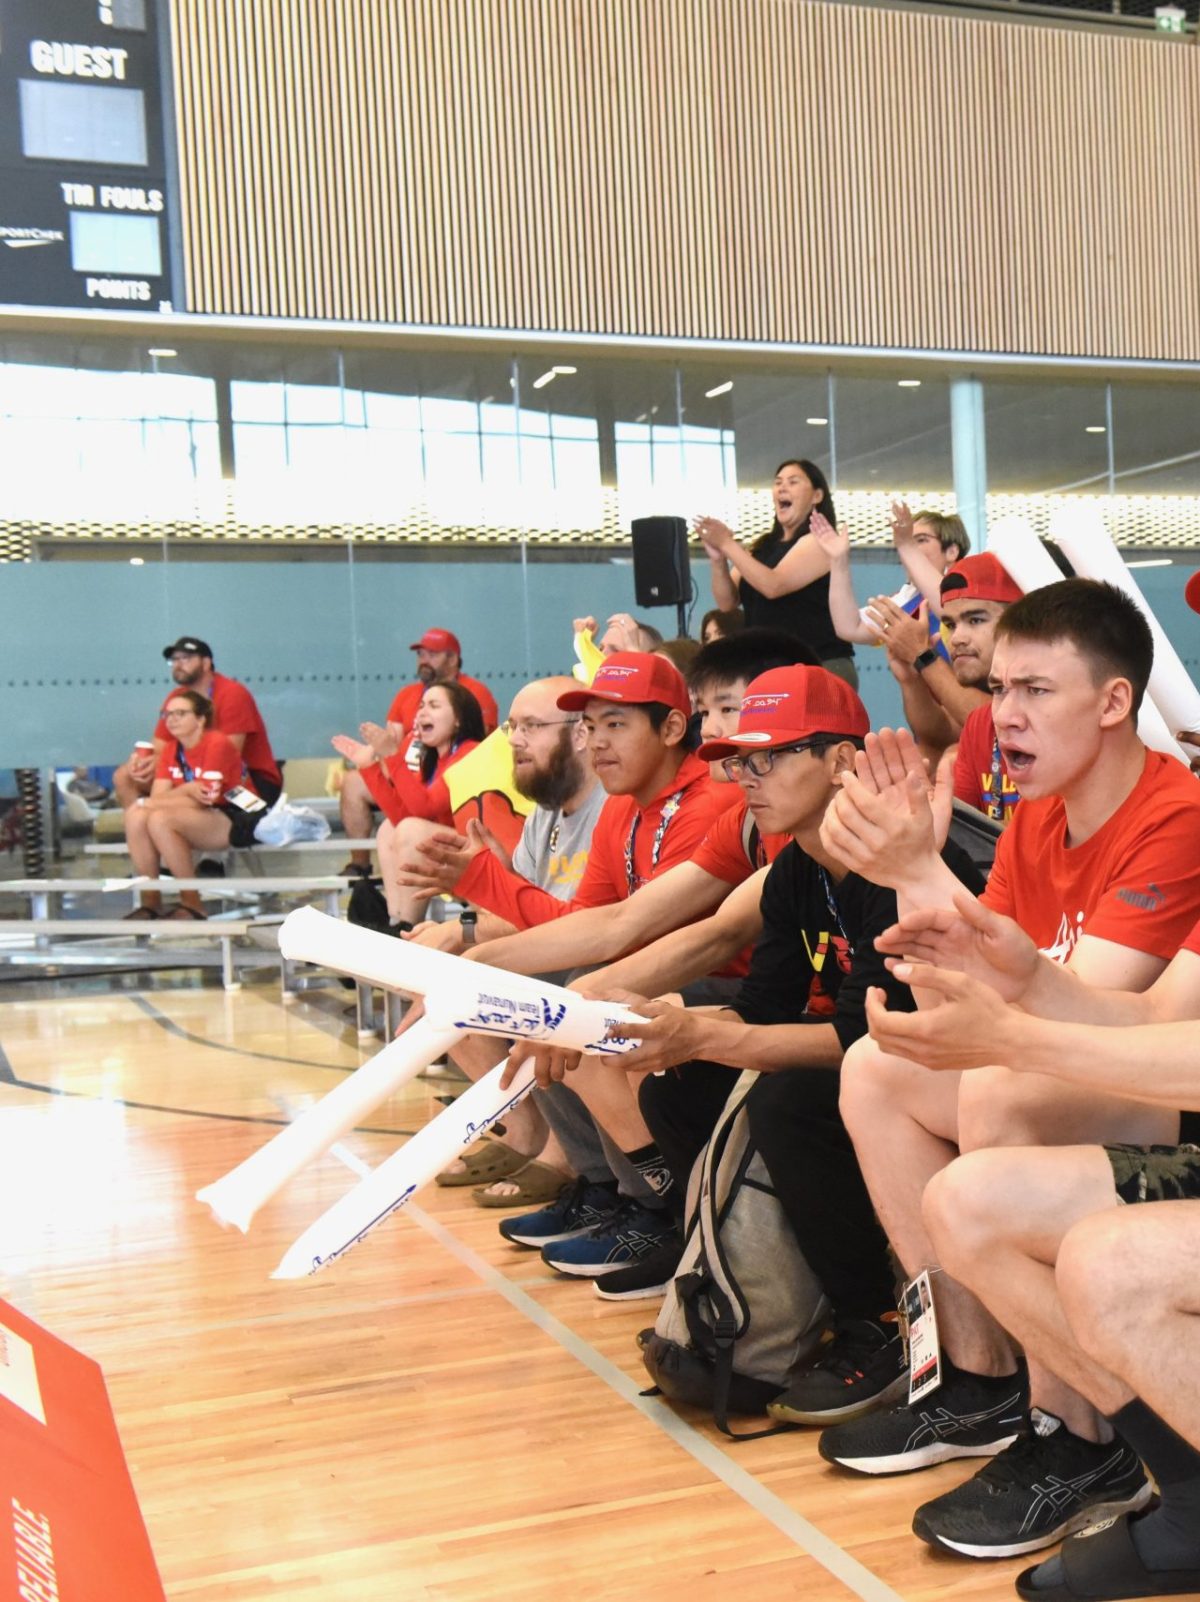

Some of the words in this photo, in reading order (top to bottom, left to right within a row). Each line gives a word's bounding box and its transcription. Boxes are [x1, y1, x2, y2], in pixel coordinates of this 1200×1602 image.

[30, 40, 128, 80] GUEST
[100, 185, 164, 212] FOULS
[86, 278, 151, 300] POINTS
